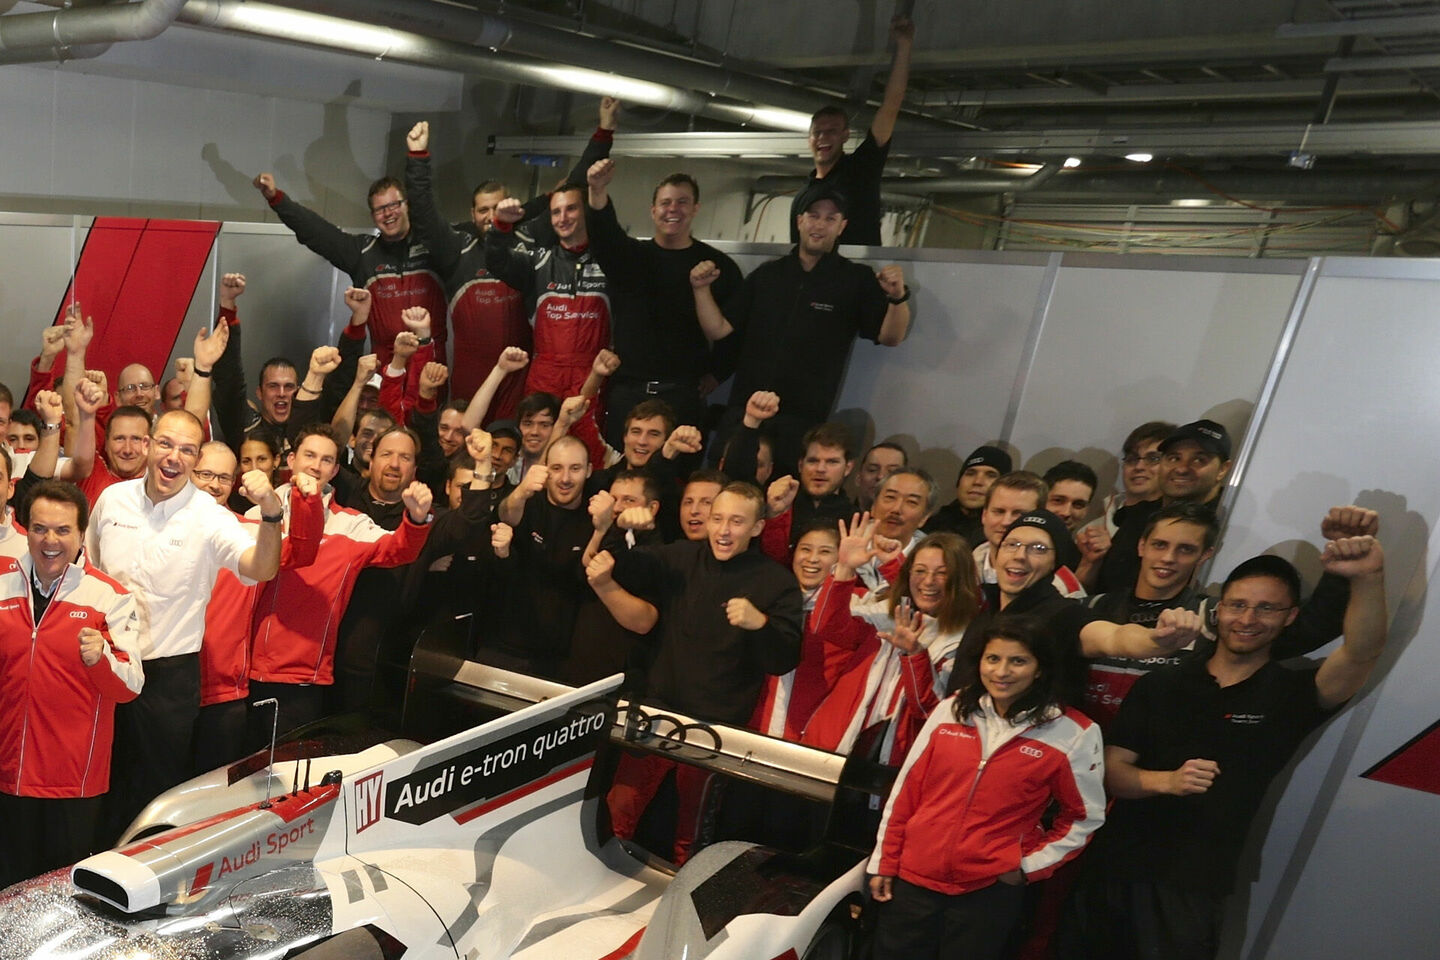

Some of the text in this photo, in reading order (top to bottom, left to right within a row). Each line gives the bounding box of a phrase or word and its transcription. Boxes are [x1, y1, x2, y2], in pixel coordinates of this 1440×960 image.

[546, 303, 568, 312] Audi
[394, 709, 607, 814] Audi e-tron quattro
[357, 773, 383, 825] HY
[217, 816, 316, 880] Audi Sport
